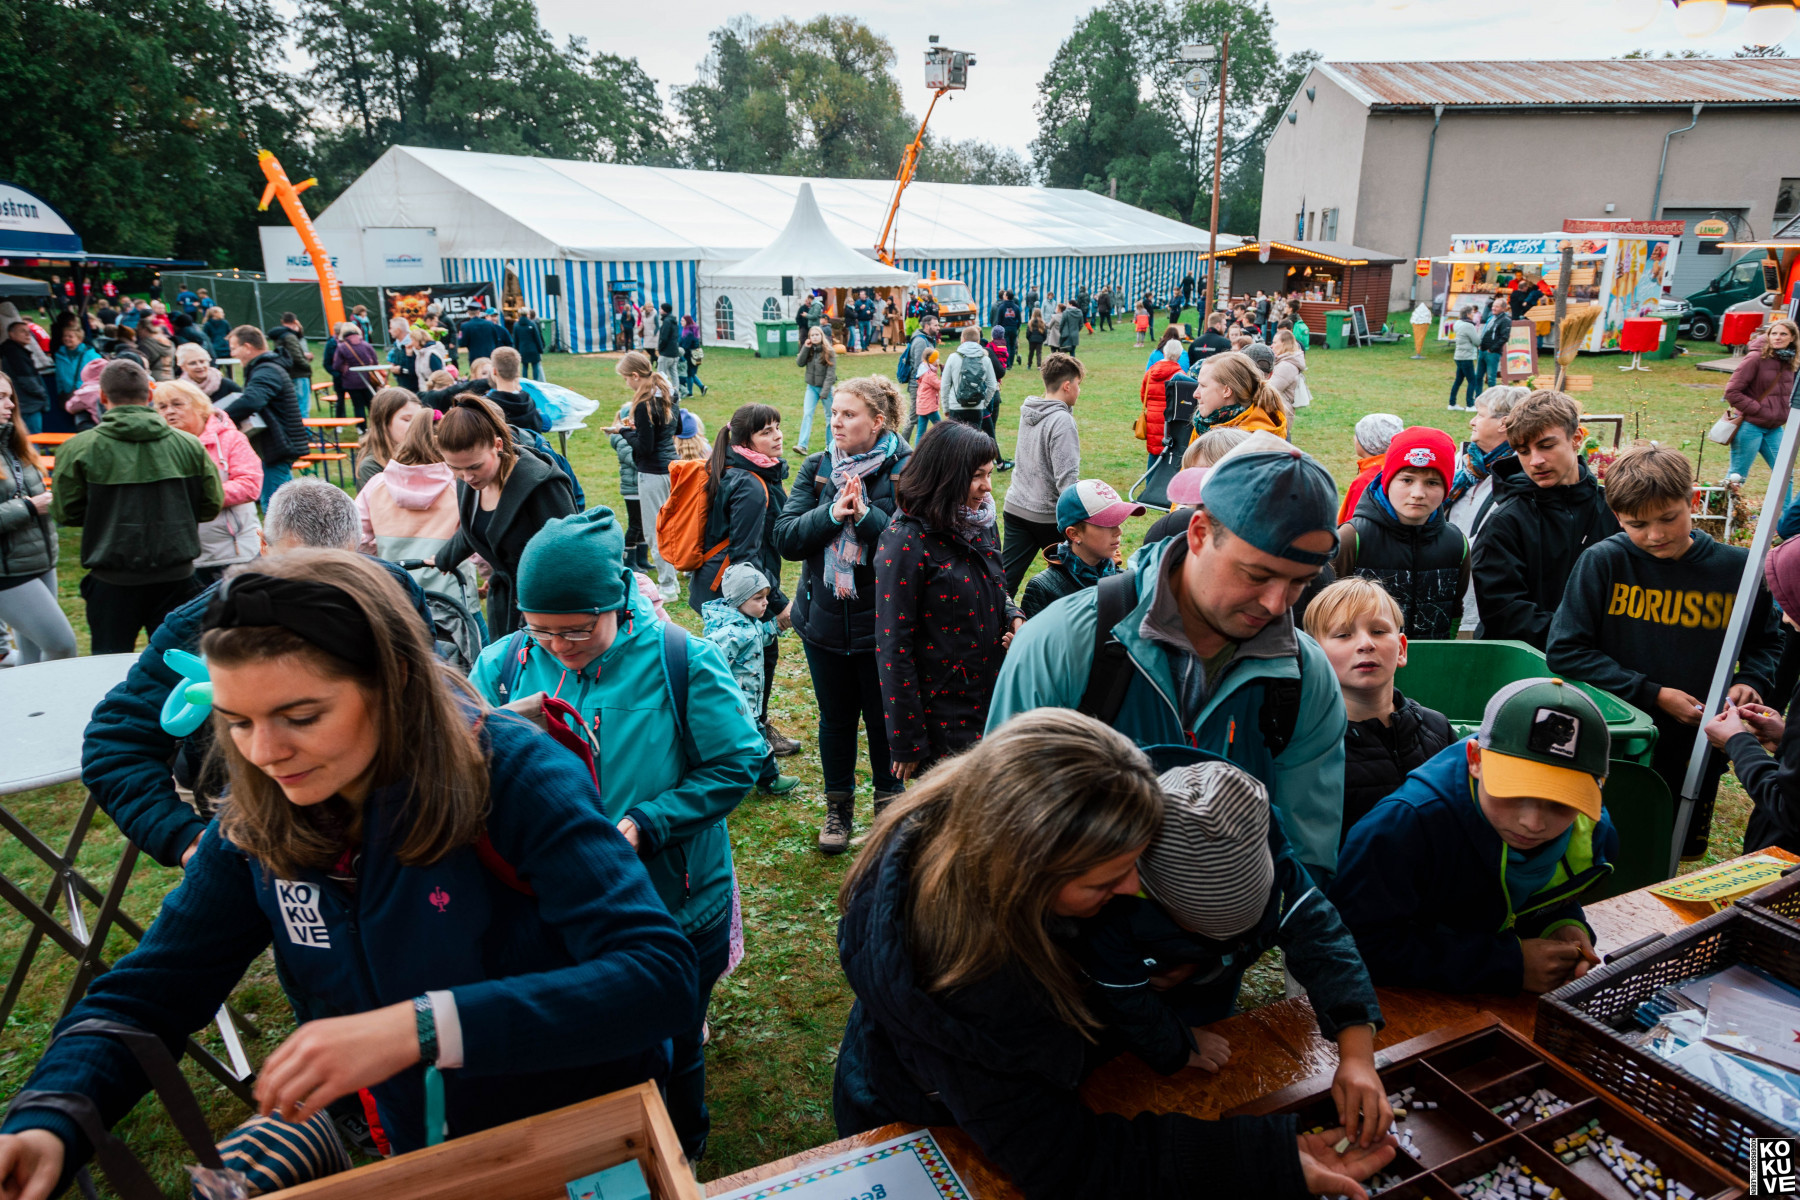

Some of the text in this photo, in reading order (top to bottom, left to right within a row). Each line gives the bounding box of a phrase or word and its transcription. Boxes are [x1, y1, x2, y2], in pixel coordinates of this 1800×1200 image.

[1608, 582, 1738, 630] BORUSSI
[279, 884, 312, 905] KO
[285, 906, 318, 923] KU
[292, 926, 330, 943] VE
